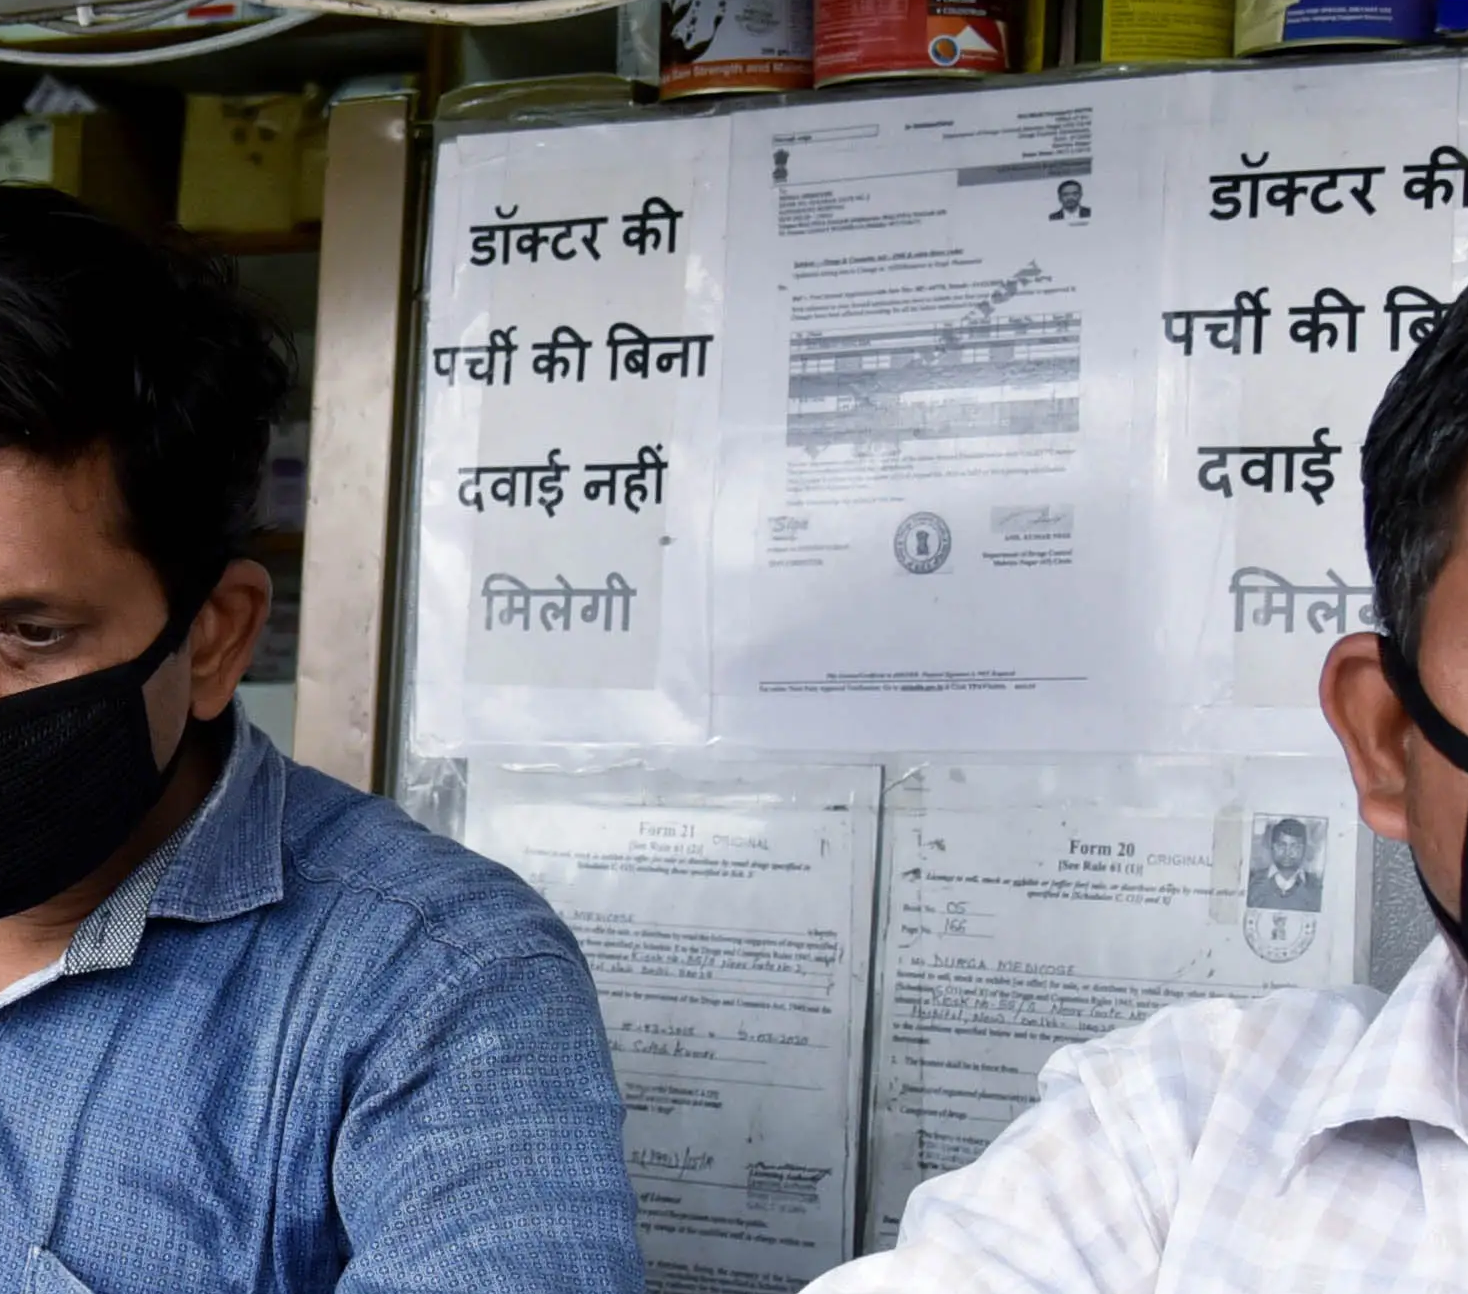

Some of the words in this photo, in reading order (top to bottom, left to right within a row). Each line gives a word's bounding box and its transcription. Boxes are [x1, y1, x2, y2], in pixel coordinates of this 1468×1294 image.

[1209, 152, 1385, 222] डॉक्टर
[469, 205, 608, 266] डॉक्टर
[622, 196, 683, 255] की
[1163, 287, 1270, 356] पर्ची
[1288, 287, 1365, 356] की
[433, 326, 518, 387] पर्ची
[532, 324, 591, 383] की
[606, 323, 714, 381] बिना
[457, 447, 570, 516] दवाई
[583, 443, 668, 513] नहीं
[1198, 427, 1342, 505] दवाई
[481, 571, 637, 633] मिलेगी
[639, 821, 674, 837] Form
[678, 823, 696, 837] 21
[1069, 839, 1111, 856] Form
[1117, 842, 1135, 858] 20
[1147, 853, 1213, 868] ORIGINAL
[1083, 860, 1107, 872] Rule
